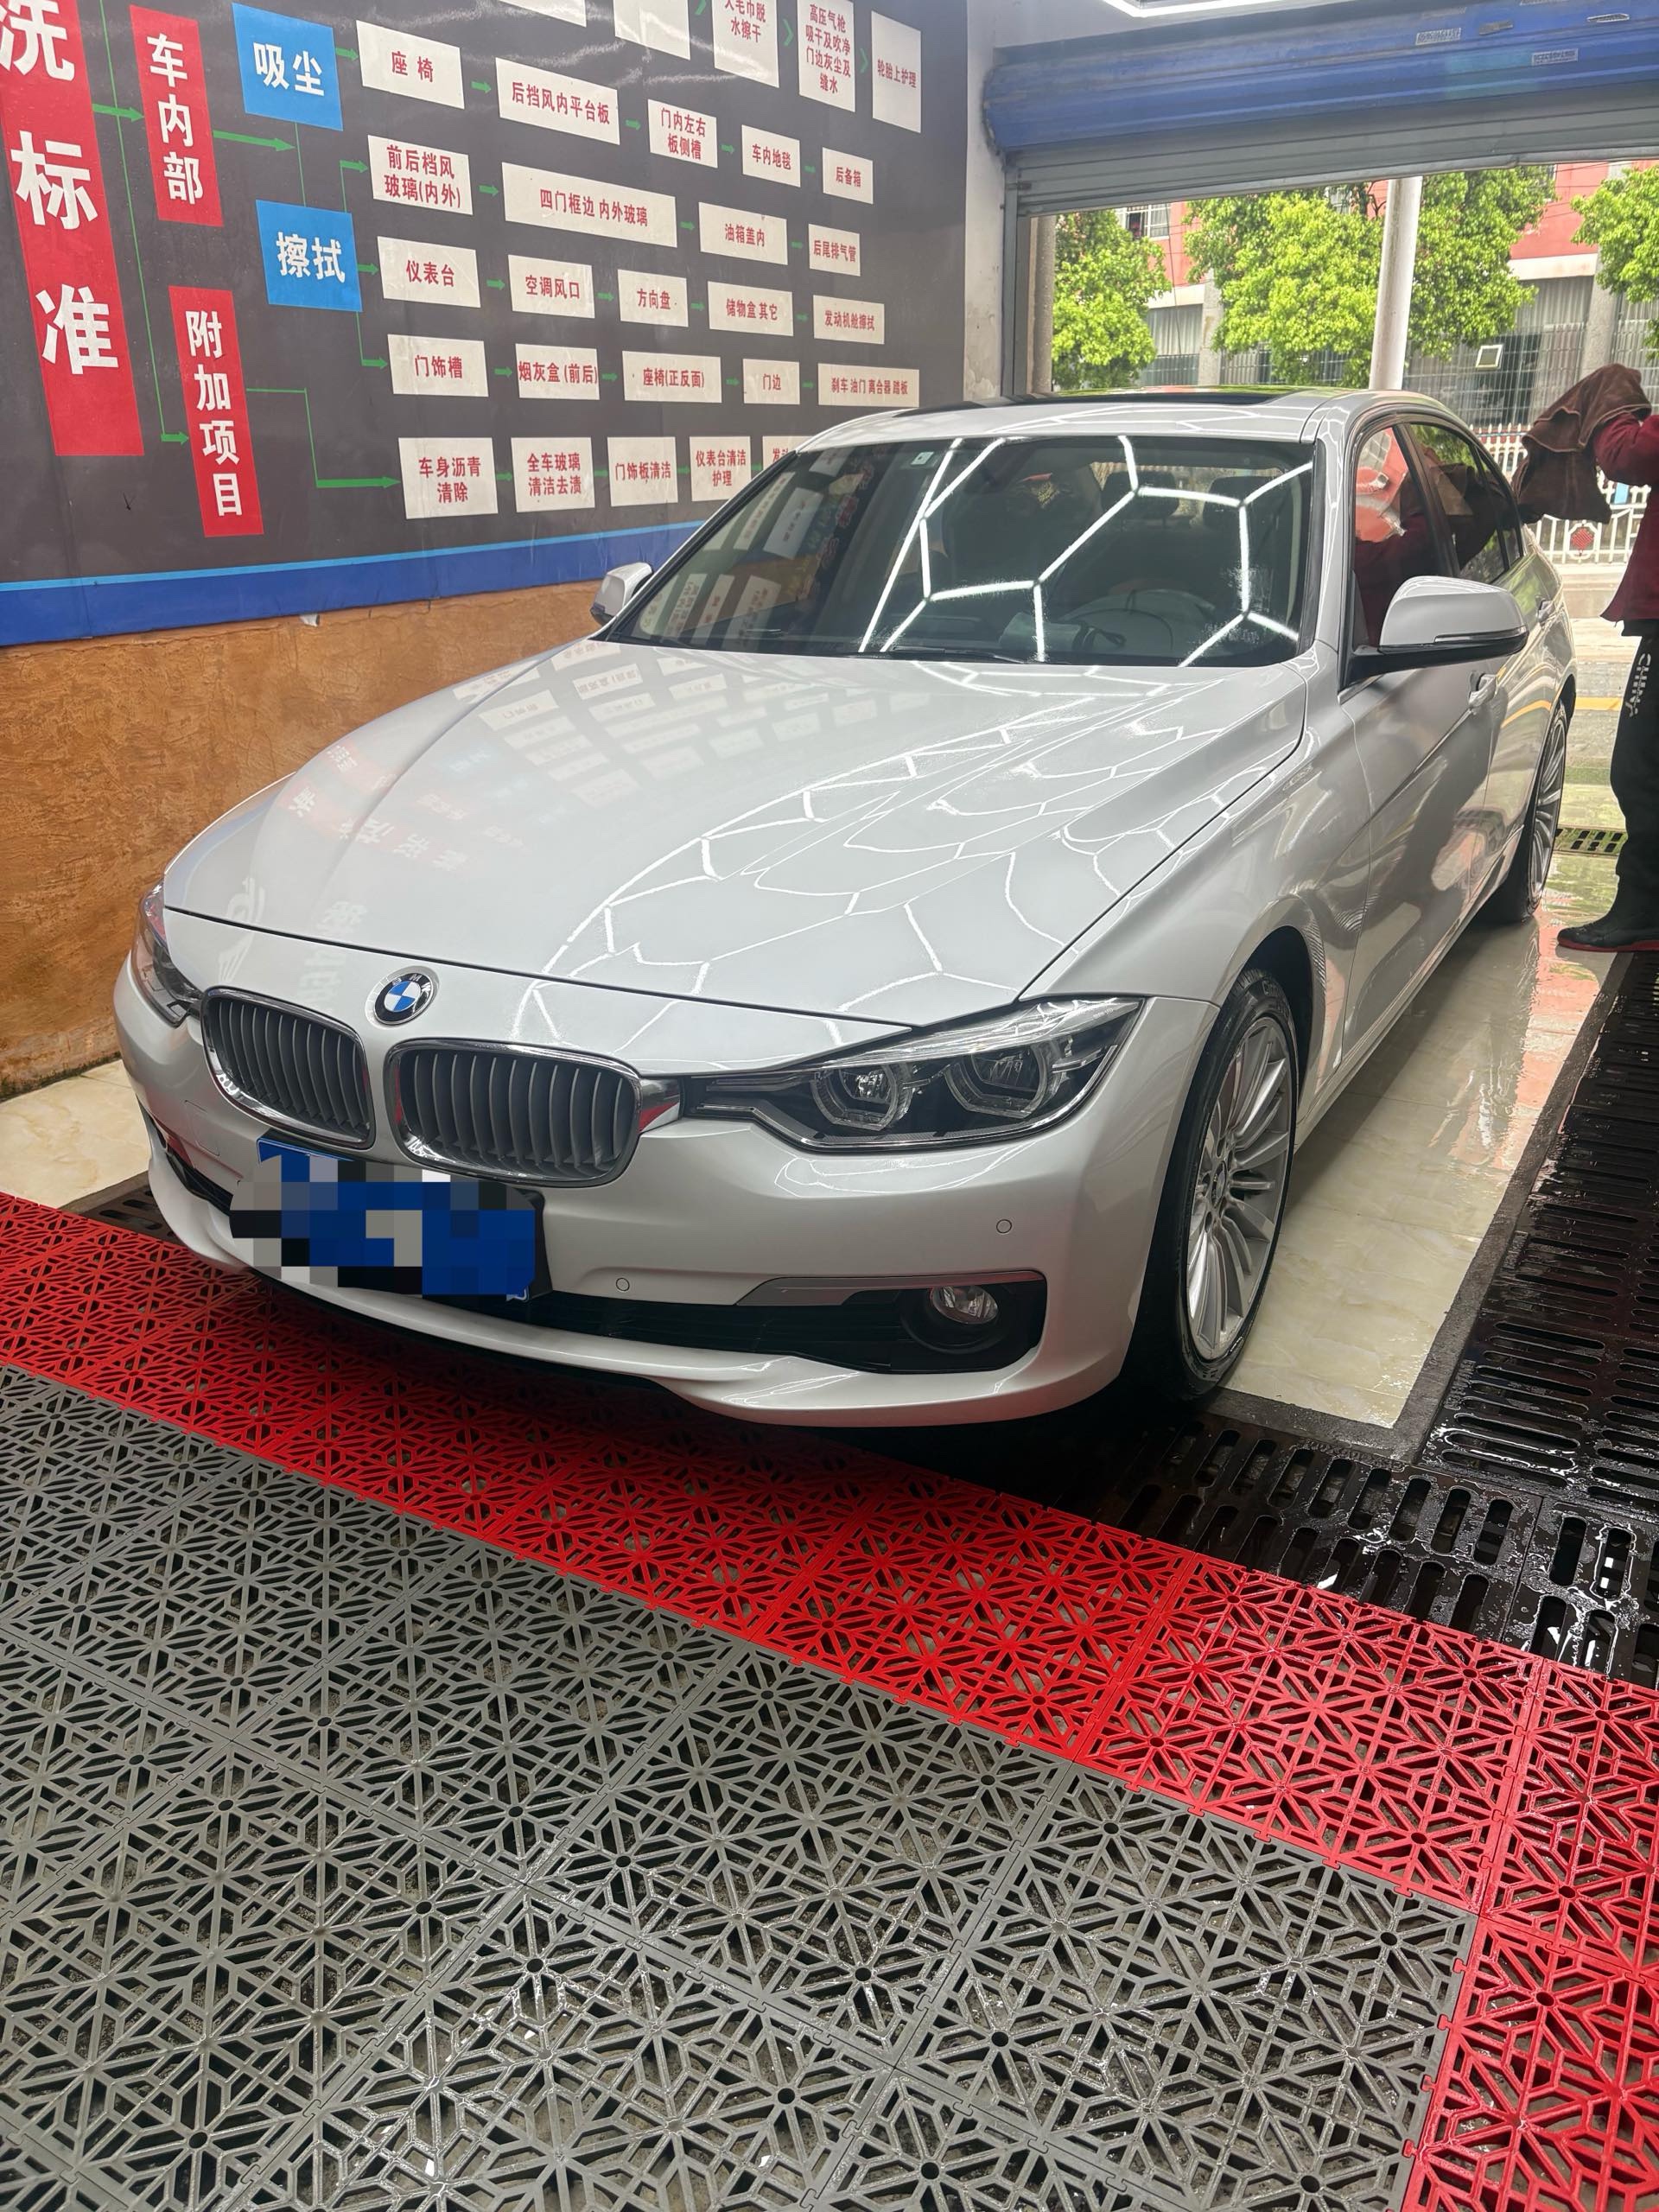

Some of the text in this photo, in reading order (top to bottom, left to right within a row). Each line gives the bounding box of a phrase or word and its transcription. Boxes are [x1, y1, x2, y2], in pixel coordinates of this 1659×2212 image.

[731, 16, 761, 43] 水擦干
[810, 3, 847, 33] 高压气枪
[805, 24, 851, 56] 吸干及吹净
[253, 42, 325, 96] 吸尘
[391, 51, 434, 83] 座椅
[806, 46, 851, 78] 门边灰尘及
[877, 59, 917, 88] 轮胎上护理
[819, 72, 838, 93] 缝水
[512, 81, 610, 124] 后挡风内平台板
[147, 34, 204, 205] 车内部
[661, 107, 706, 138] 门内左右
[667, 133, 702, 161] 板侧槽
[752, 143, 792, 170] 车内地毯
[836, 166, 861, 188] 后备箱
[384, 174, 461, 208] 玻璃(内外)
[724, 223, 766, 248] 油箱盖内
[276, 232, 346, 283] 擦拭
[813, 239, 857, 263] 后尾排气管
[405, 260, 455, 288] 仪表台
[524, 275, 582, 300] 空调风口
[637, 289, 671, 311] 方向盘
[824, 309, 875, 331] 发动机舱擦拭
[414, 354, 464, 379] 门饰槽
[643, 366, 705, 388] 座椅(正反面)
[762, 373, 782, 391] 门边
[185, 310, 243, 517] 附加项目
[418, 455, 481, 479] 车身沥青
[527, 451, 582, 473] 全车玻璃
[696, 448, 747, 467] 仪表台清洁
[614, 461, 672, 481] 门饰板清洁
[711, 470, 733, 488] 护理
[437, 480, 468, 504] 清除
[528, 474, 582, 496] 清洁去渍
[1624, 652, 1652, 718] CHINA
